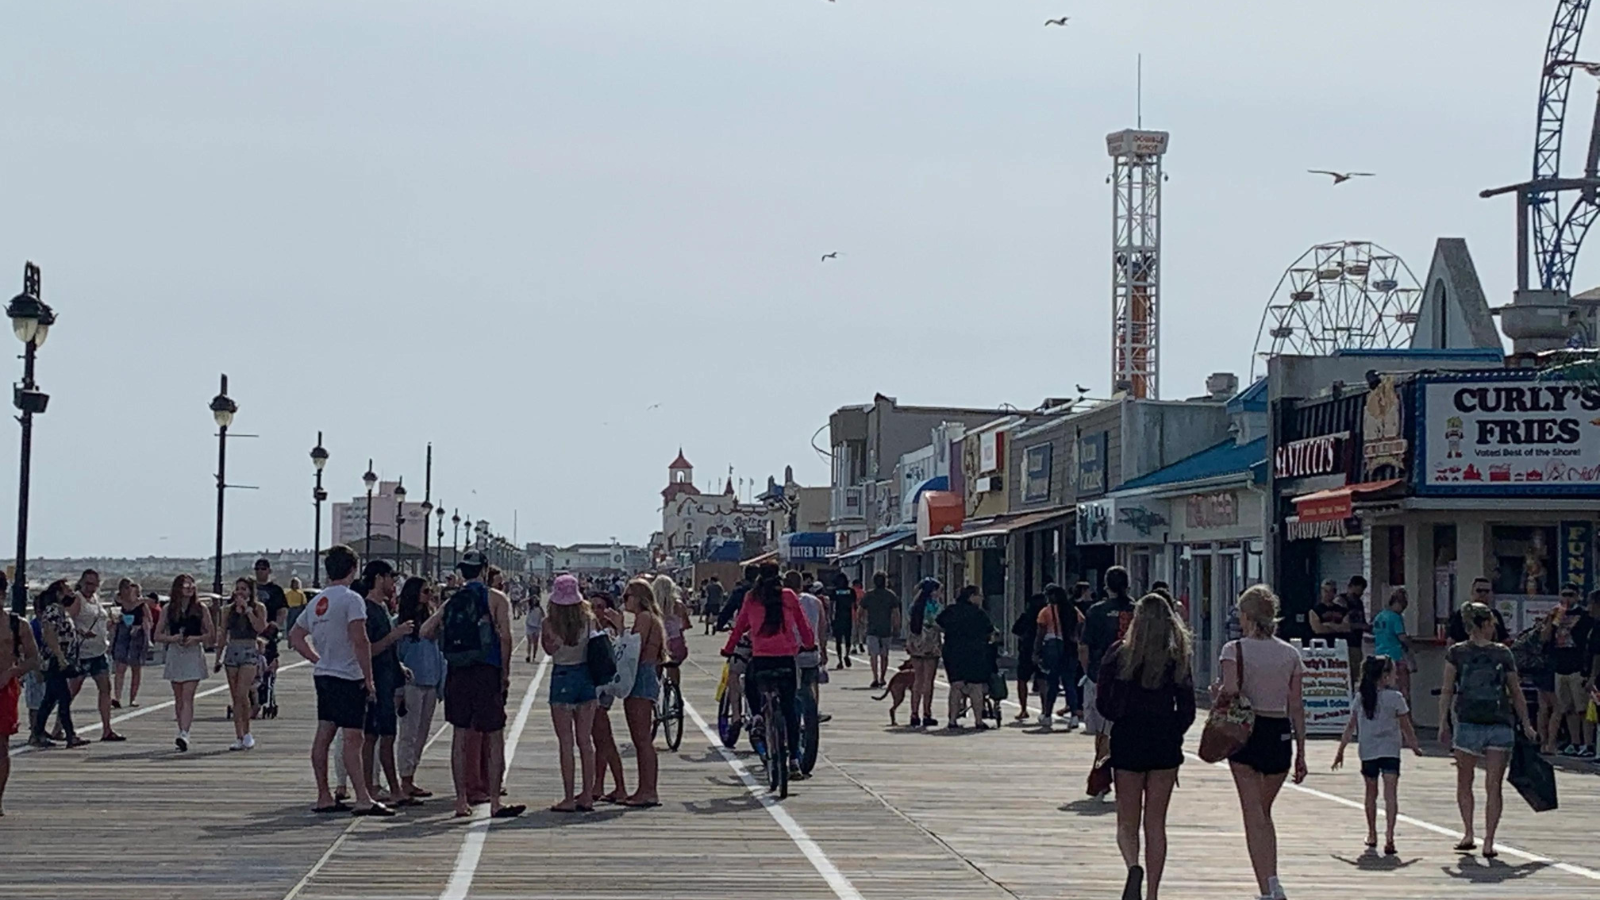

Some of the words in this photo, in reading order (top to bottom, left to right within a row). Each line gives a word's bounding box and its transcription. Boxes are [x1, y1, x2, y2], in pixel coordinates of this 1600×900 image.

[1453, 386, 1600, 413] CURLY'S
[1475, 418, 1580, 445] FRIES
[1474, 448, 1501, 457] Voted
[1503, 448, 1522, 457] Best
[1524, 448, 1533, 457] of
[1535, 448, 1551, 457] the
[1552, 448, 1581, 457] Shore!
